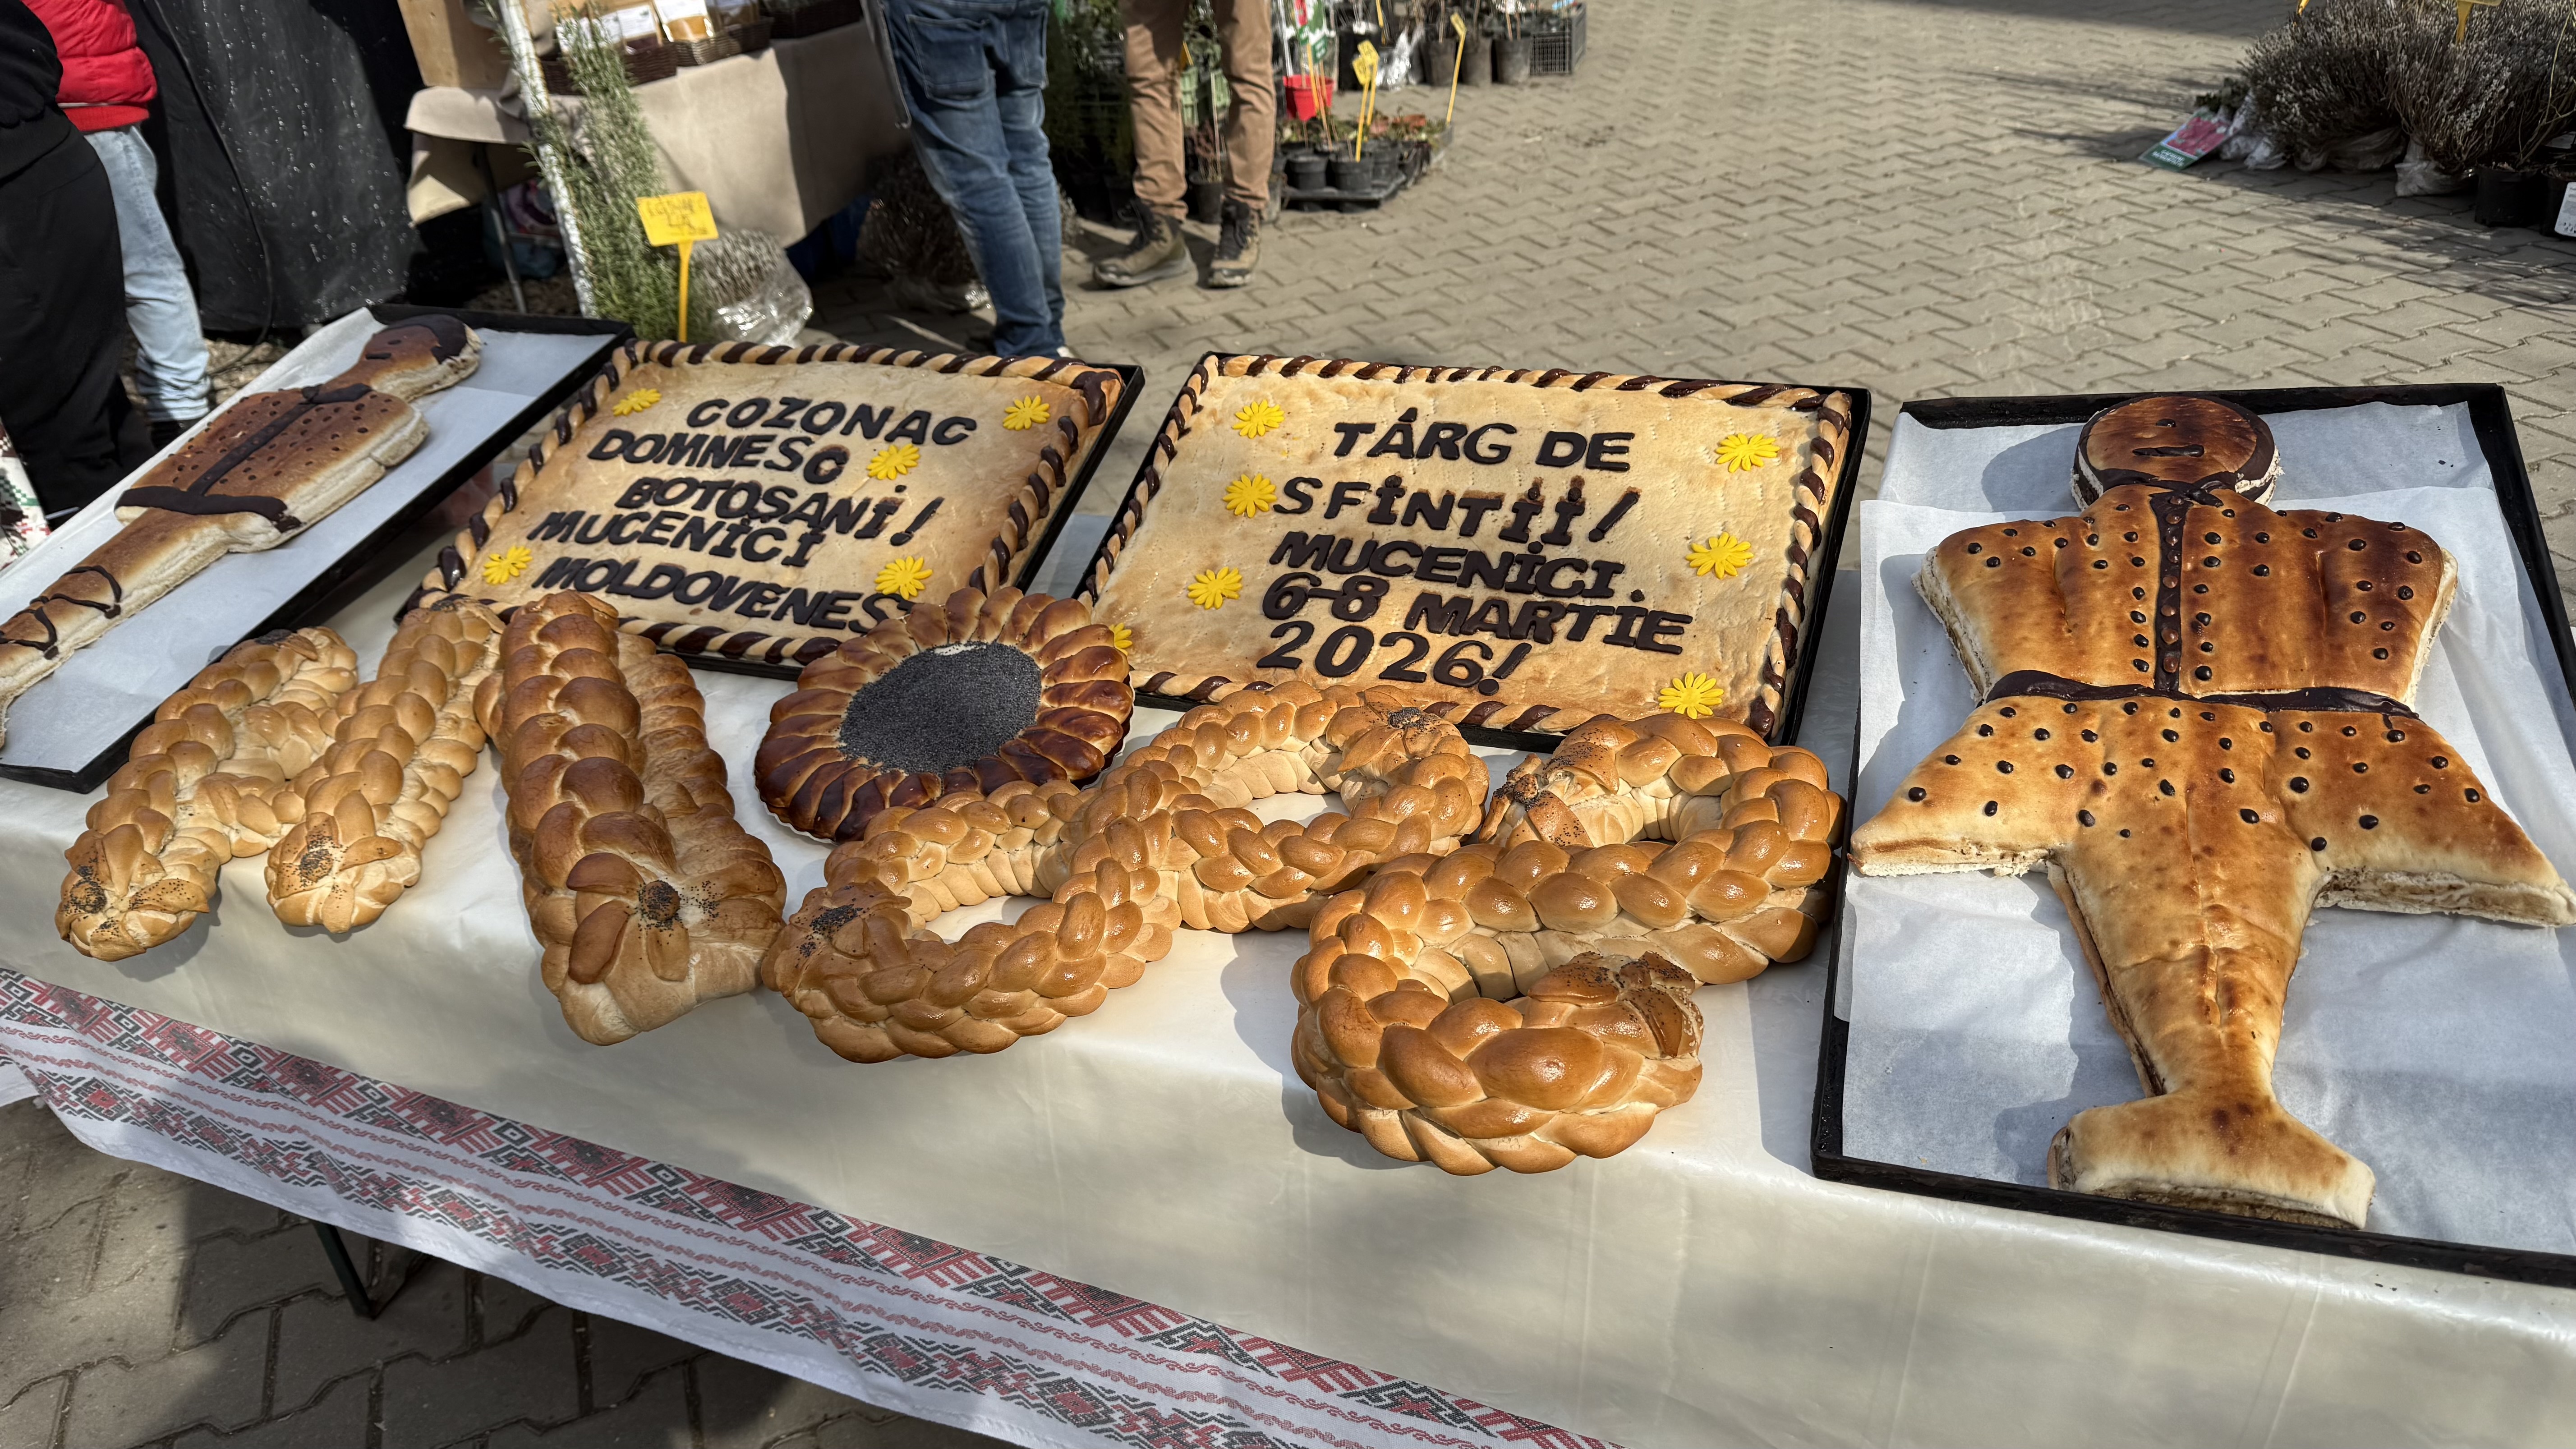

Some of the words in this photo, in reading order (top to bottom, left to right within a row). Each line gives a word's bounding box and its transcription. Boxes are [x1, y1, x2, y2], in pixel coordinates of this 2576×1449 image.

[686, 397, 978, 445] COZONAC
[587, 428, 849, 484] DOMNESC
[1535, 431, 1635, 472] DE
[1262, 571, 1390, 621] 6-8
[1403, 589, 1694, 656] MARTIE
[1256, 620, 1532, 696] 2026!
